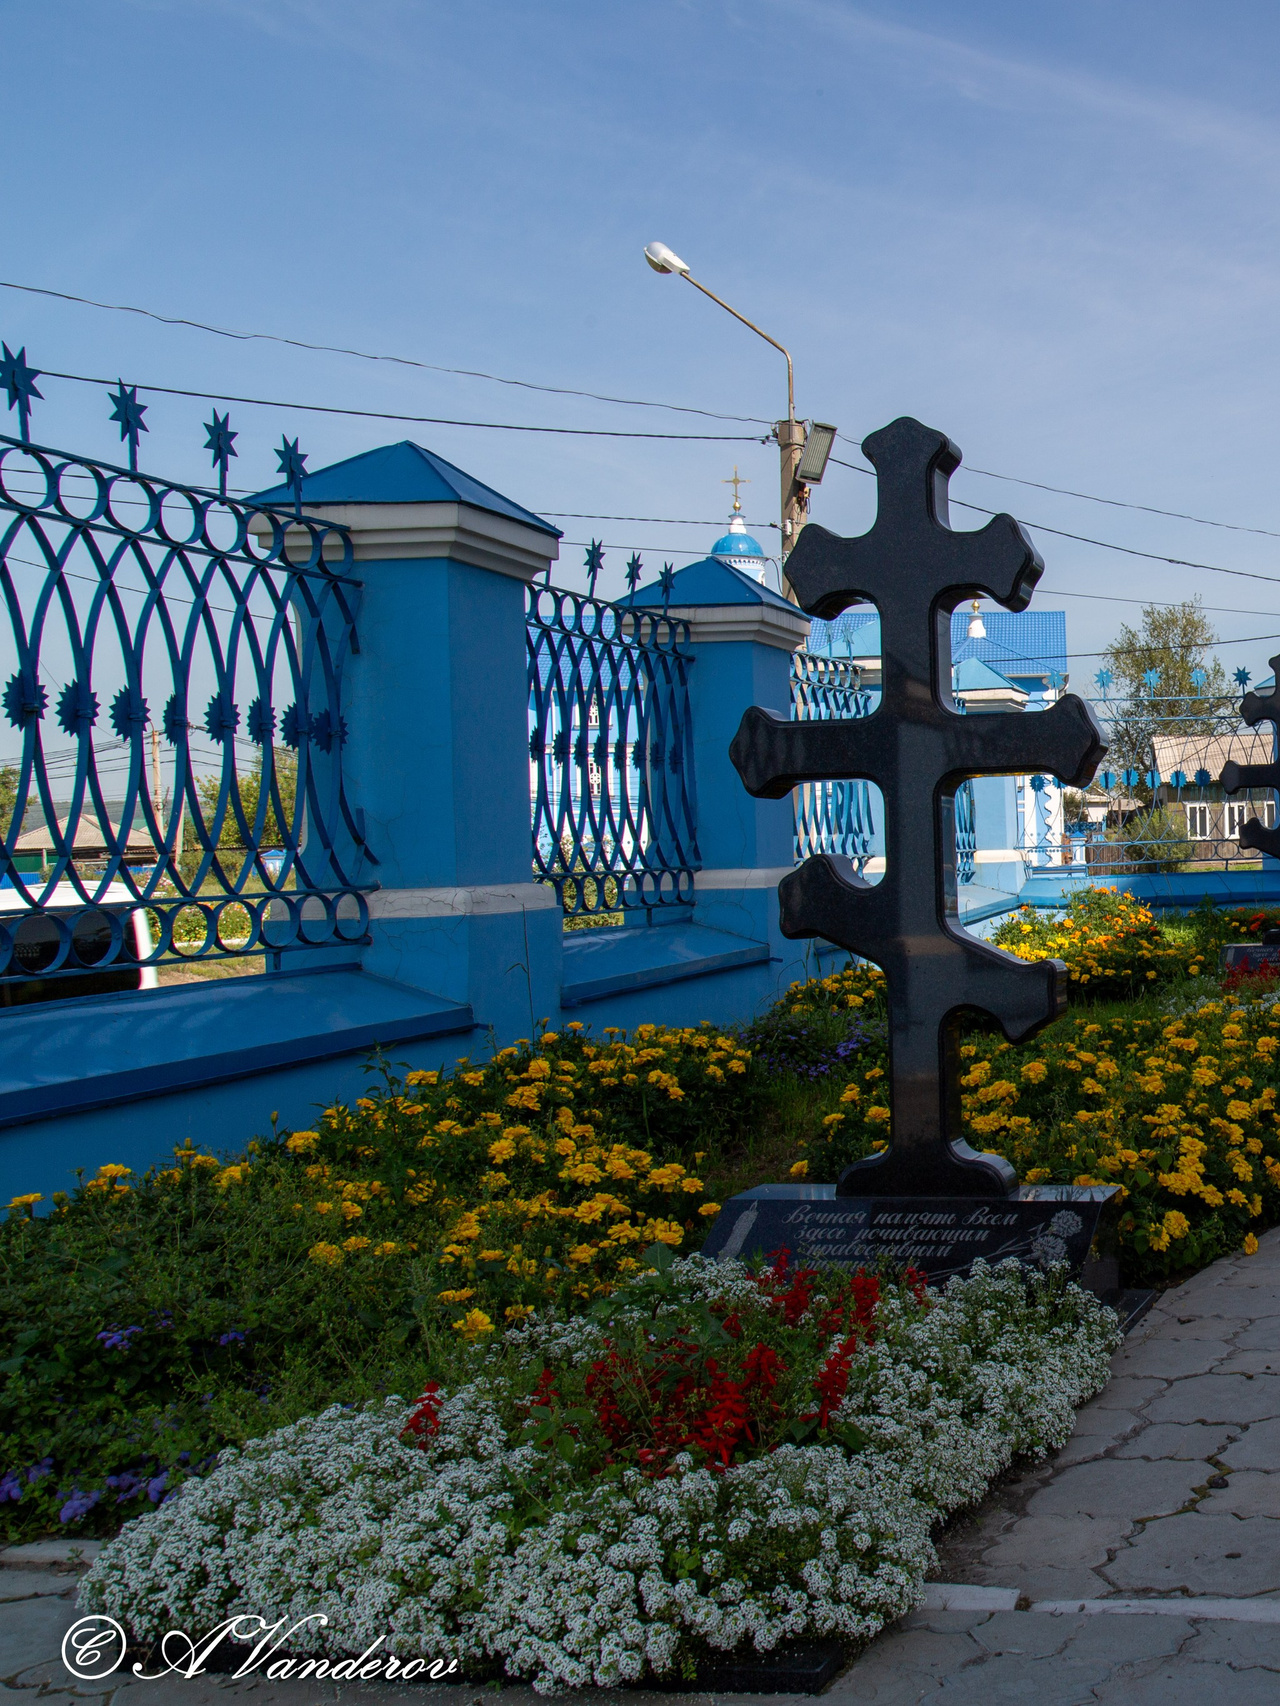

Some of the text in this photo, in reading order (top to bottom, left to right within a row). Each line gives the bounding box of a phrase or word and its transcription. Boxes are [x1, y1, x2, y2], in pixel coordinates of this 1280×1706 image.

[782, 1204, 1019, 1225] Вечная память Всем
[855, 1225, 990, 1243] почивающим
